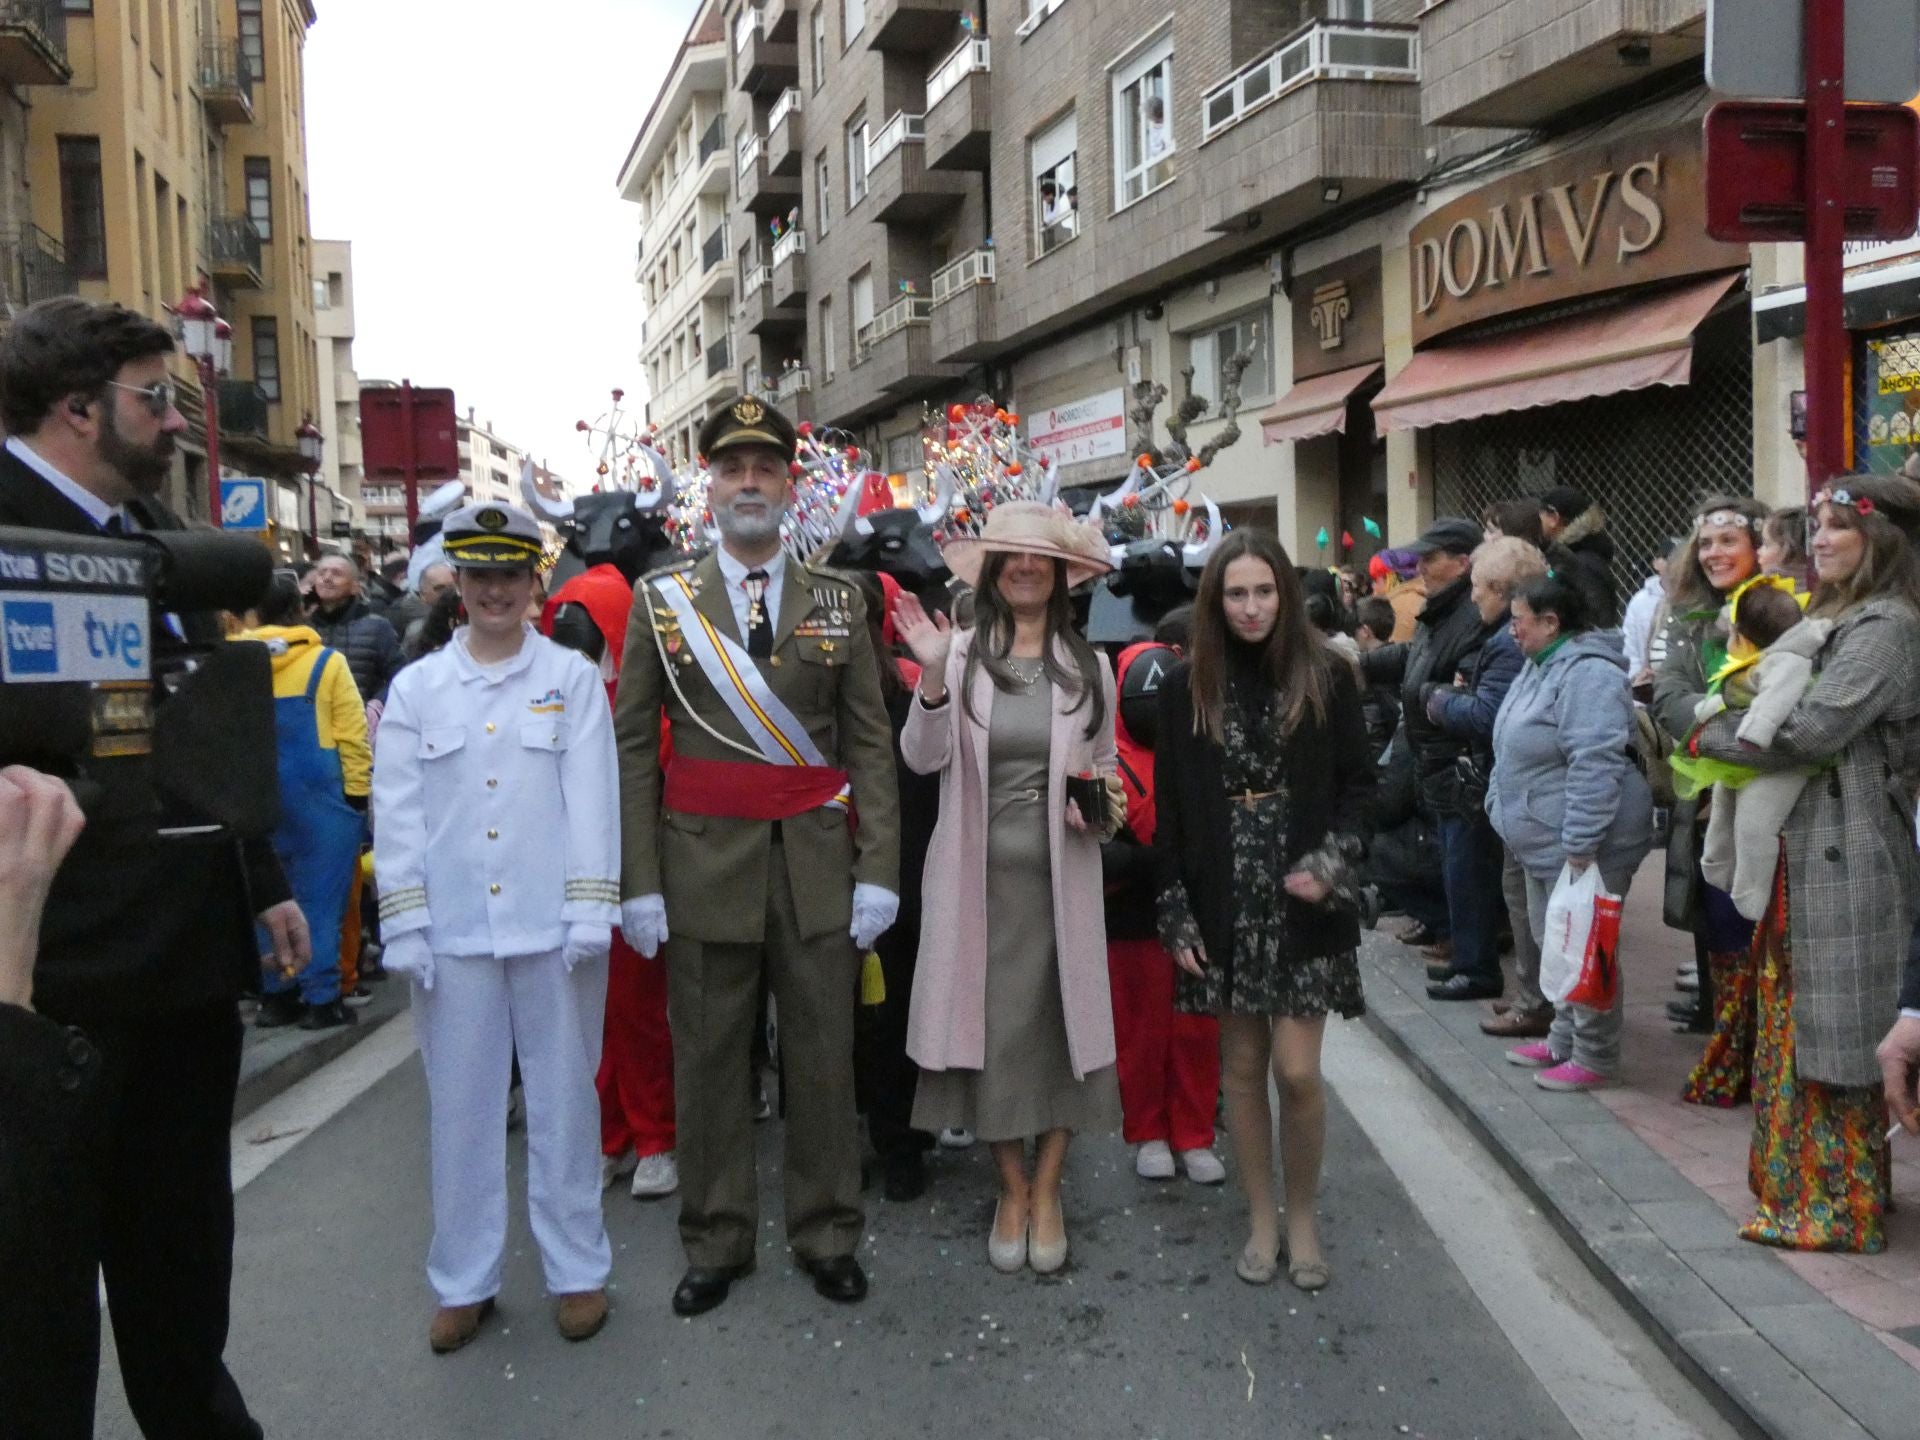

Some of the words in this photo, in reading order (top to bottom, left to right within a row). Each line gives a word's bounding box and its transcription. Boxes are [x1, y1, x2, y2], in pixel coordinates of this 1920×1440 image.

[1416, 152, 1664, 314] DOMVS
[44, 552, 141, 584] SONY
[8, 619, 53, 651] tve
[85, 610, 142, 668] tve
